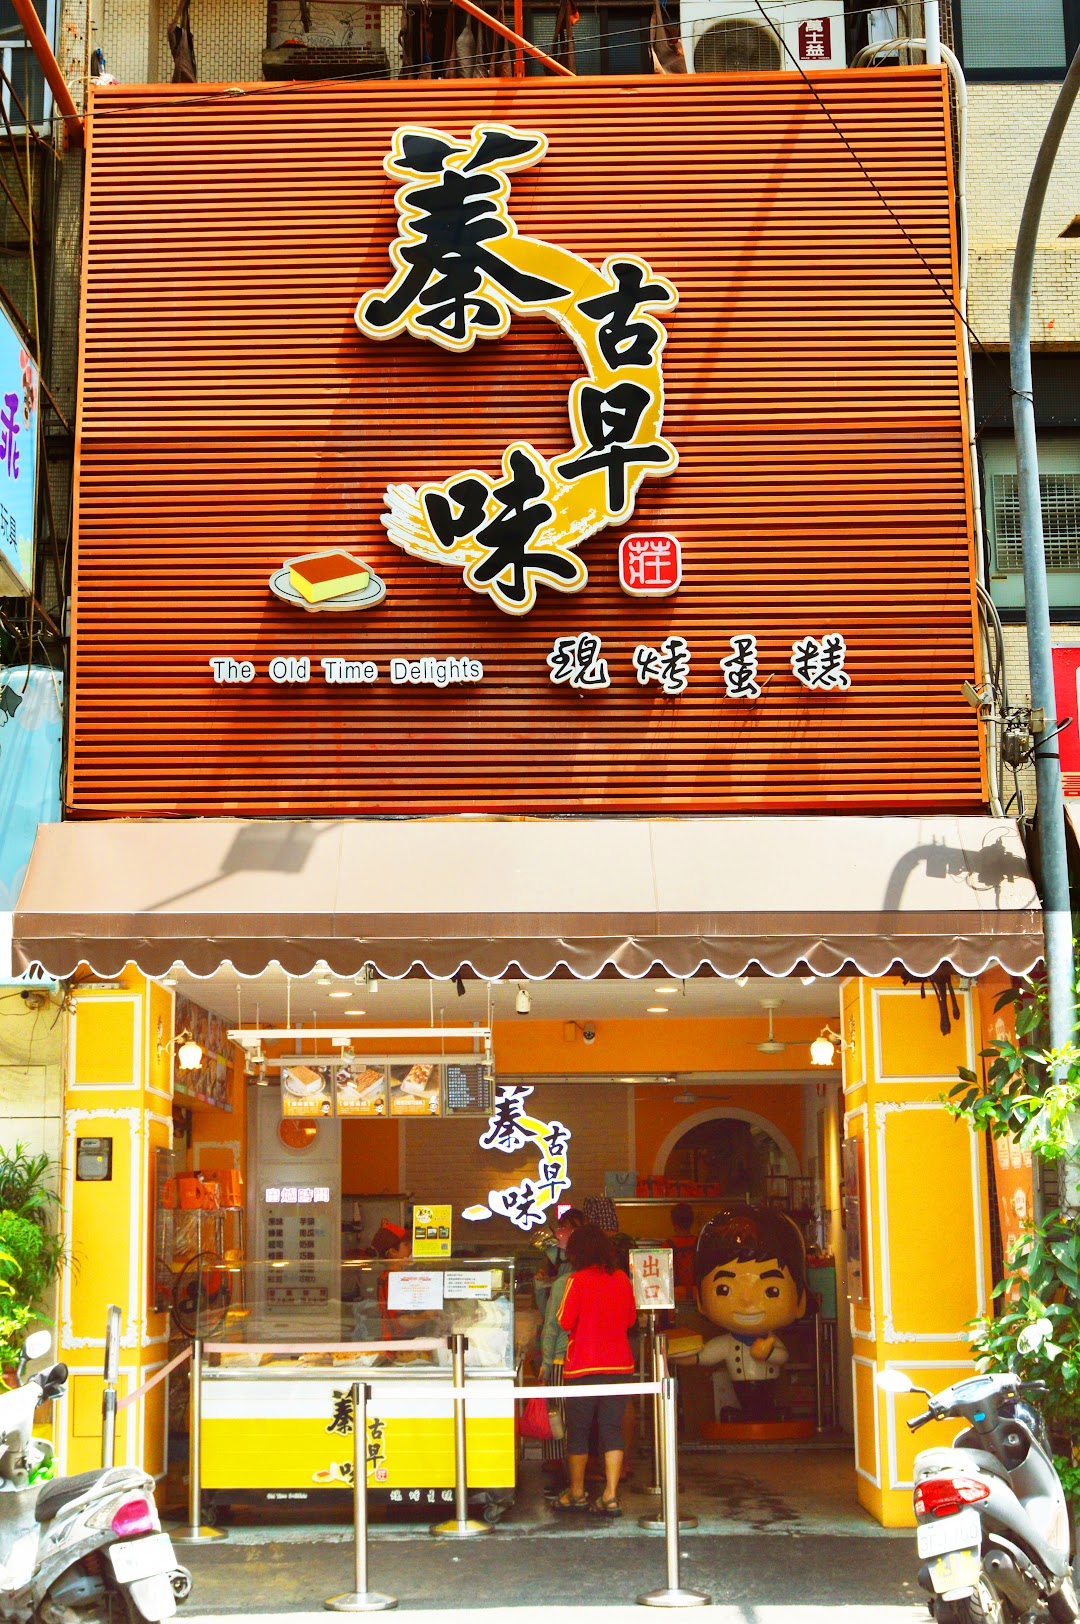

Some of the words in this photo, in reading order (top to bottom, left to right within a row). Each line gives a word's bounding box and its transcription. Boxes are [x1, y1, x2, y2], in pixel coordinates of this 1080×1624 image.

[213, 660, 252, 680] The
[272, 660, 307, 680] Old
[325, 660, 375, 680] Time
[394, 659, 480, 684] Delights
[550, 636, 848, 695] 現烤蛋糕
[643, 1255, 660, 1299] 出口
